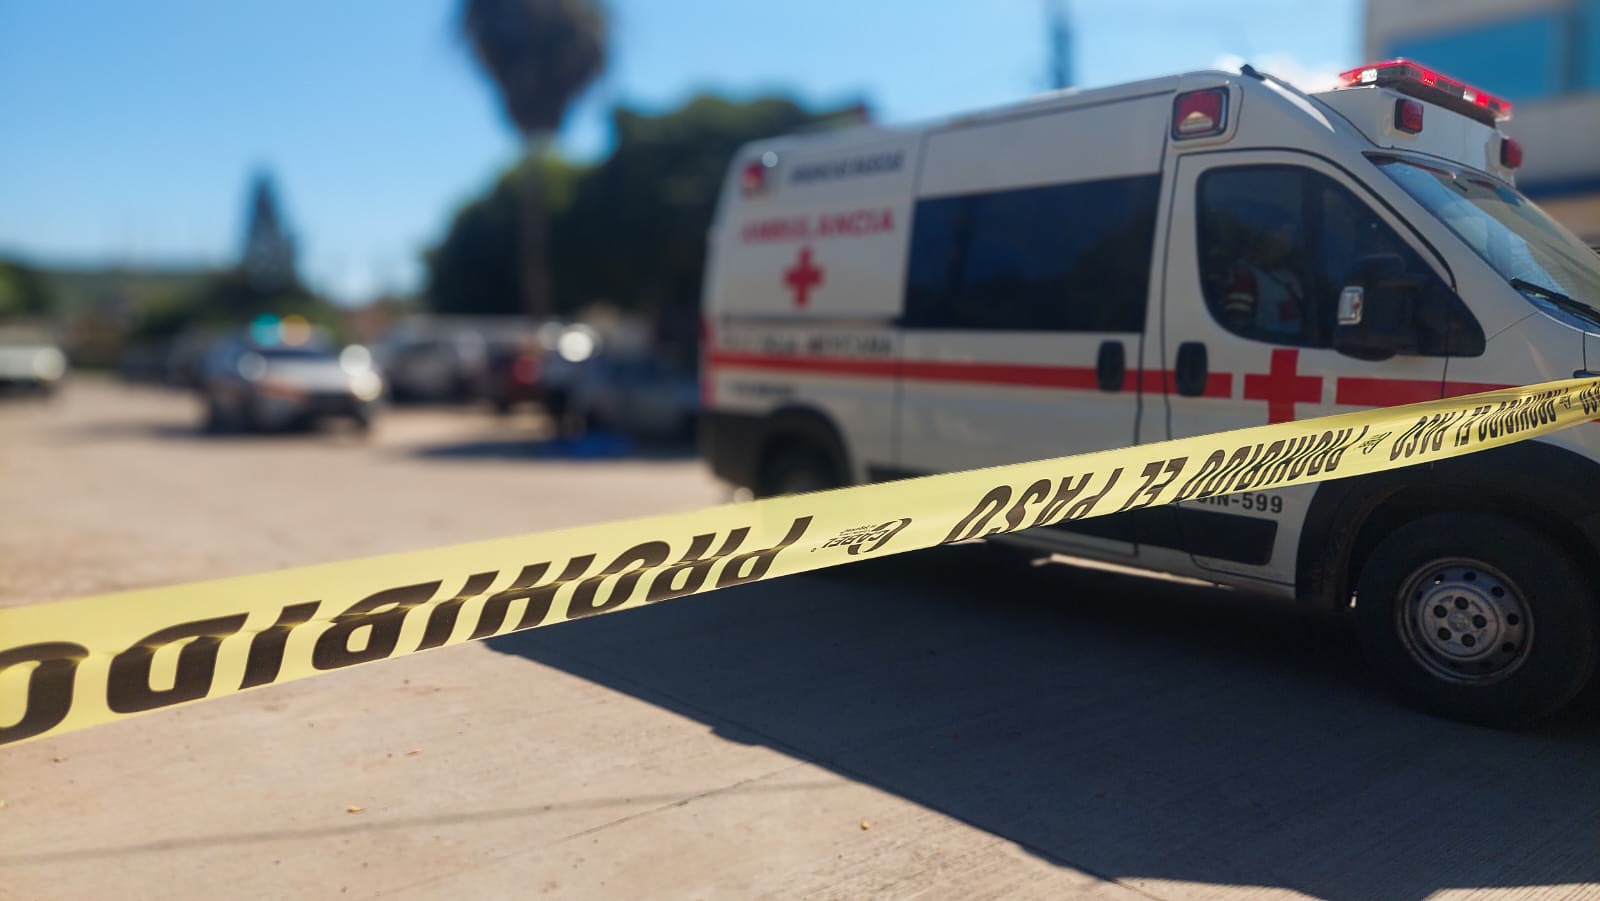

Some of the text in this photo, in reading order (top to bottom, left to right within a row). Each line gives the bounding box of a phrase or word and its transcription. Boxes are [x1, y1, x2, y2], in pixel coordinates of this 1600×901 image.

[1390, 409, 1467, 461] PASO
[1454, 405, 1491, 447] EL
[940, 425, 1369, 544] PROHIBIDO EL PASO
